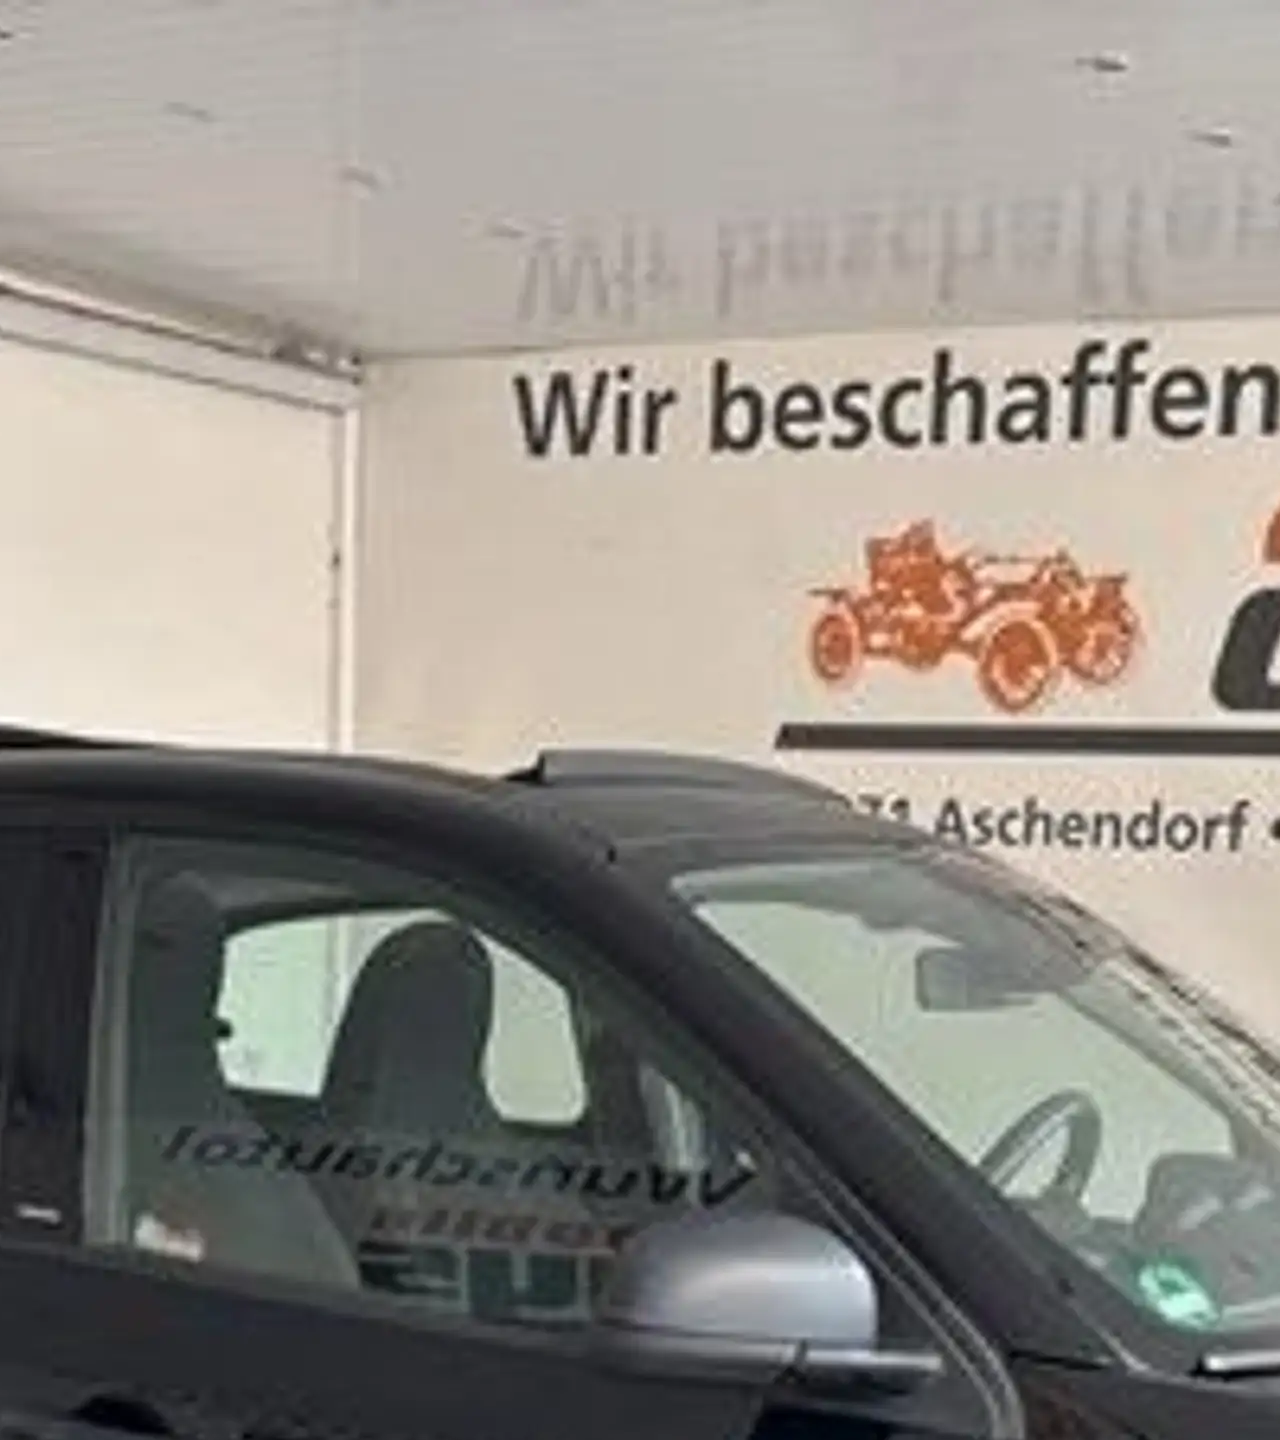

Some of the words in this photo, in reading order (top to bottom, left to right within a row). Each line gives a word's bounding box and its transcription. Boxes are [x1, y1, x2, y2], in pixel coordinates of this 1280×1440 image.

[514, 365, 676, 457] Wir
[710, 340, 1280, 452] beschaffen
[935, 796, 1251, 852] Aschendorf
